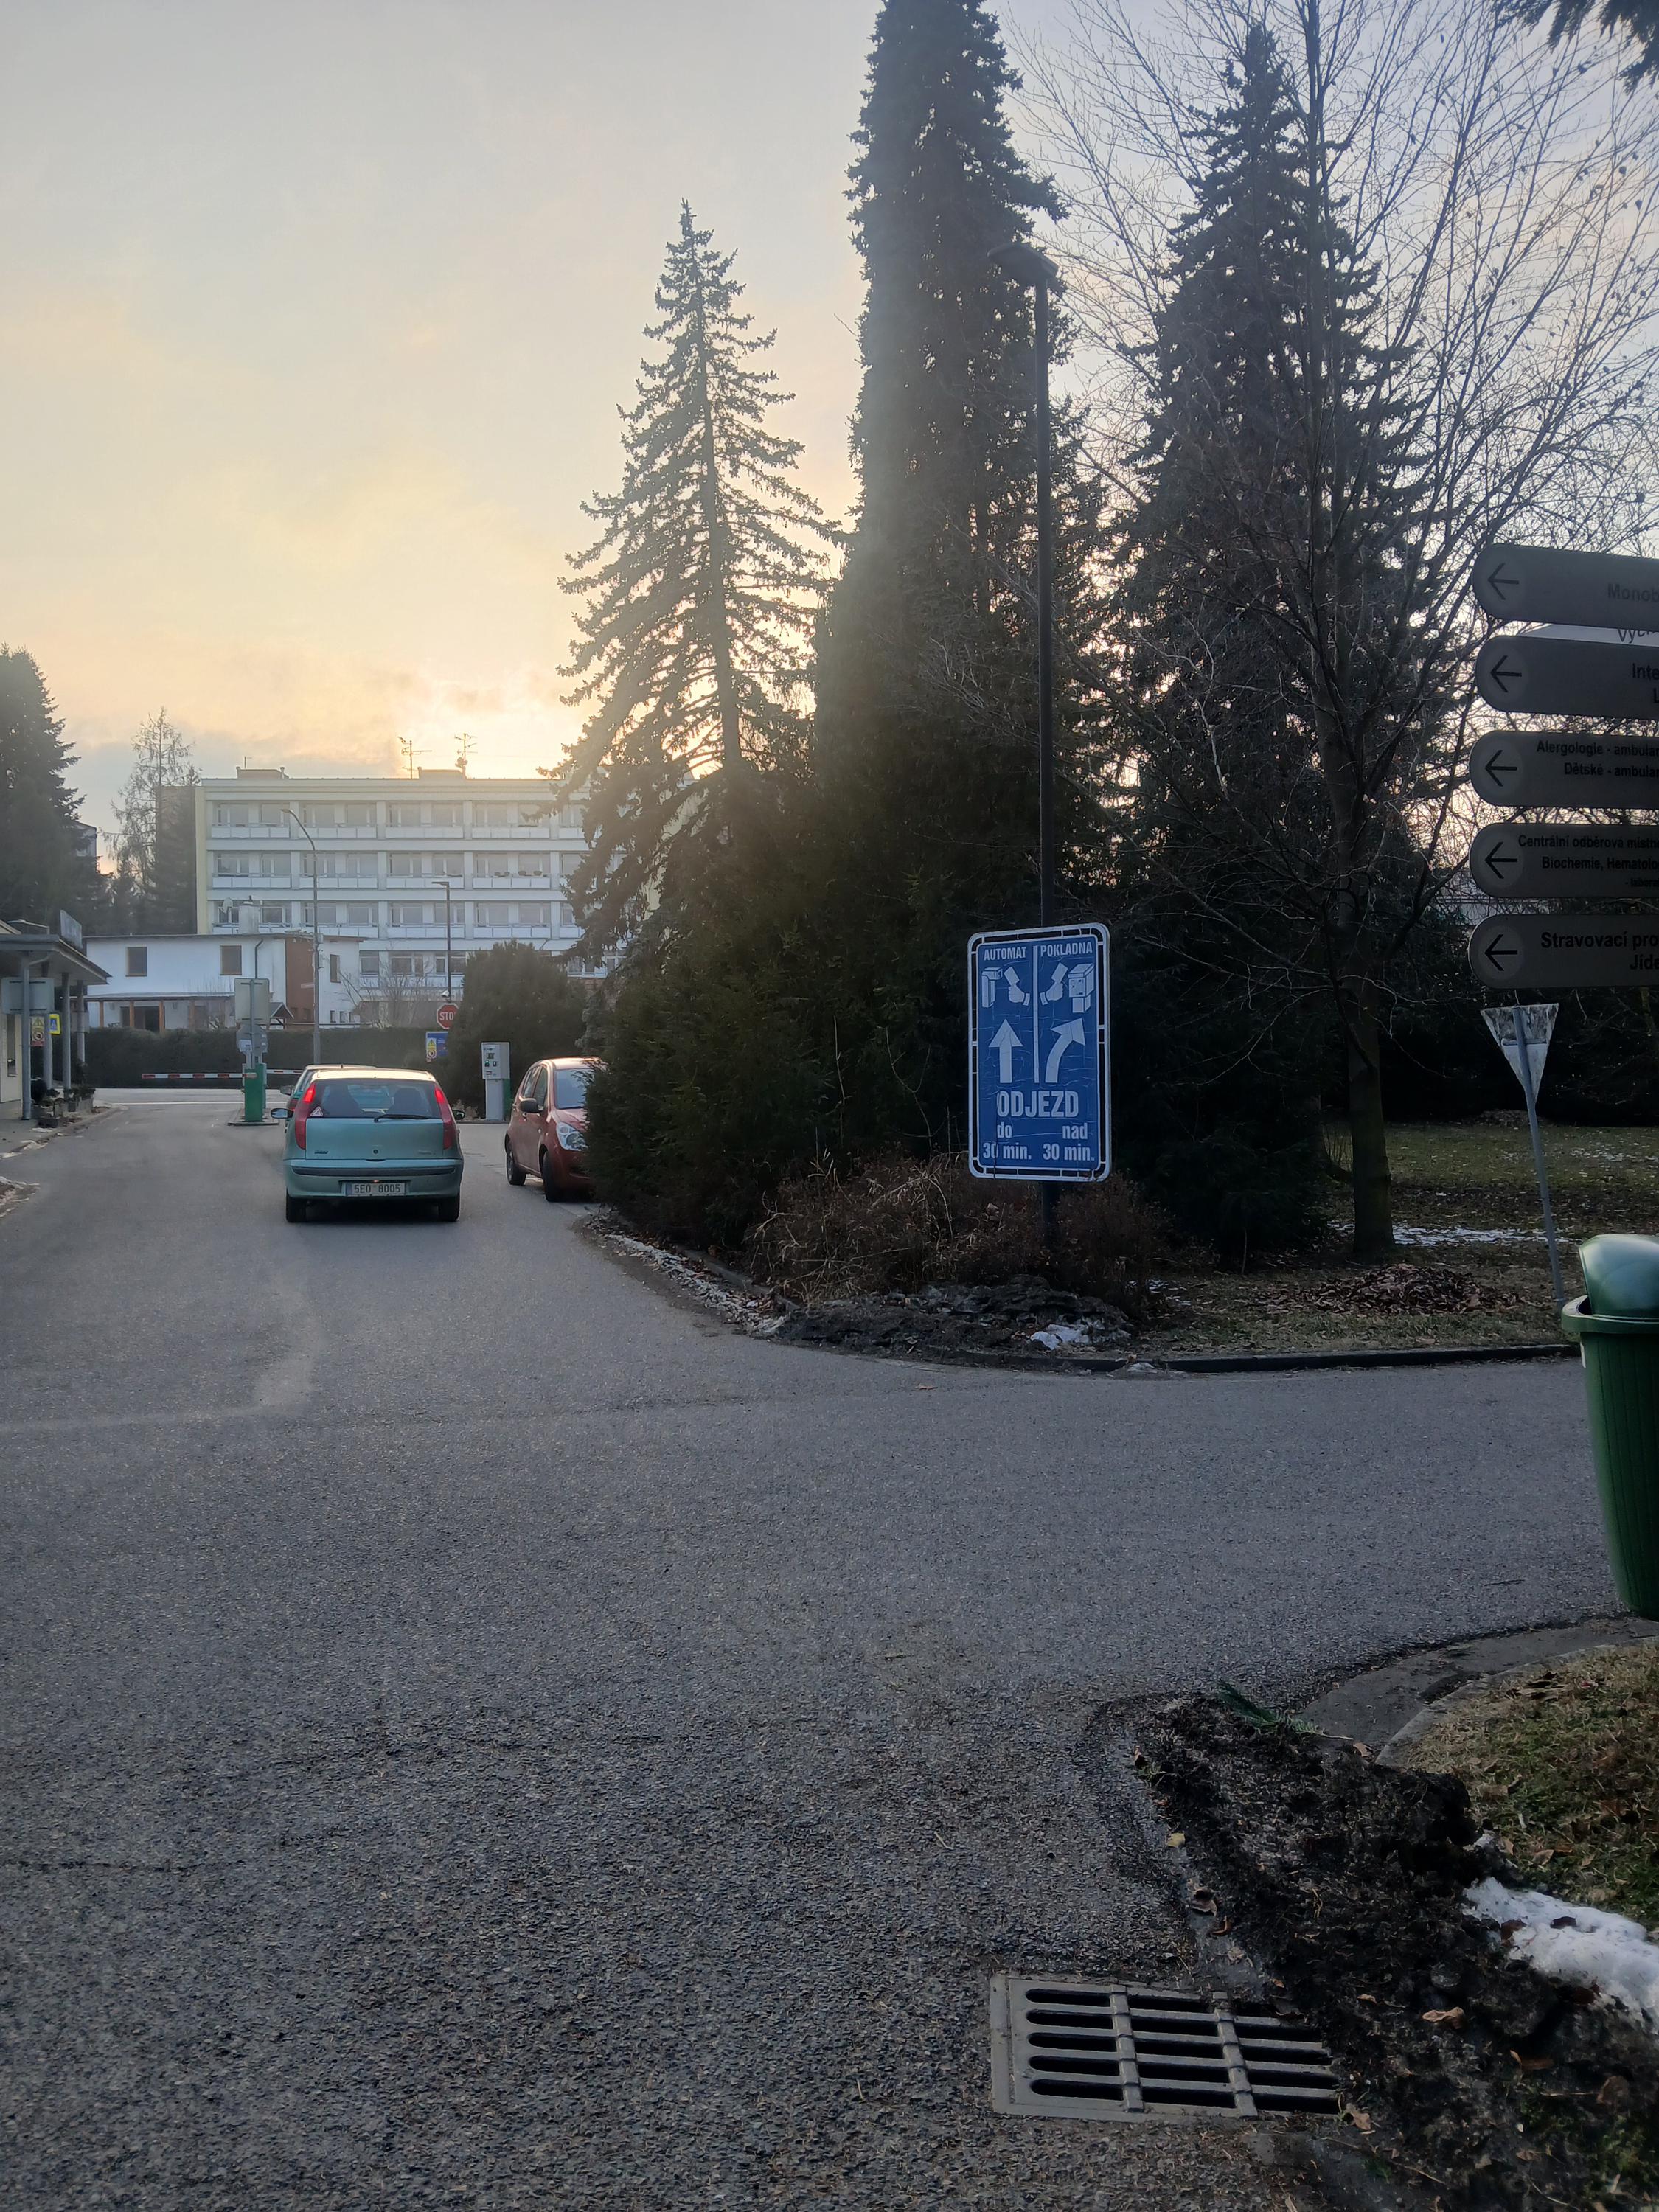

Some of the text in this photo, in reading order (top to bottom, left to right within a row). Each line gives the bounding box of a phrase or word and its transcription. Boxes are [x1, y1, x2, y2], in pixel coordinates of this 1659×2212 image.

[1536, 740, 1604, 757] Alergologie
[1564, 762, 1604, 776] Dětské
[1518, 834, 1570, 848] Centrální
[1572, 835, 1624, 848] odběrová
[1542, 856, 1604, 871] Biochemie,
[1540, 931, 1628, 948] Stravovací
[984, 947, 1027, 961] AUTOMAT
[1040, 942, 1093, 957] POKLADNA
[439, 1011, 454, 1021] STO
[997, 1091, 1079, 1118] ODJEZD
[997, 1121, 1012, 1138] do
[1062, 1122, 1088, 1140] nad
[983, 1142, 1032, 1160] 30 min.
[1043, 1143, 1095, 1161] 30 min.
[378, 1183, 400, 1194] 8005
